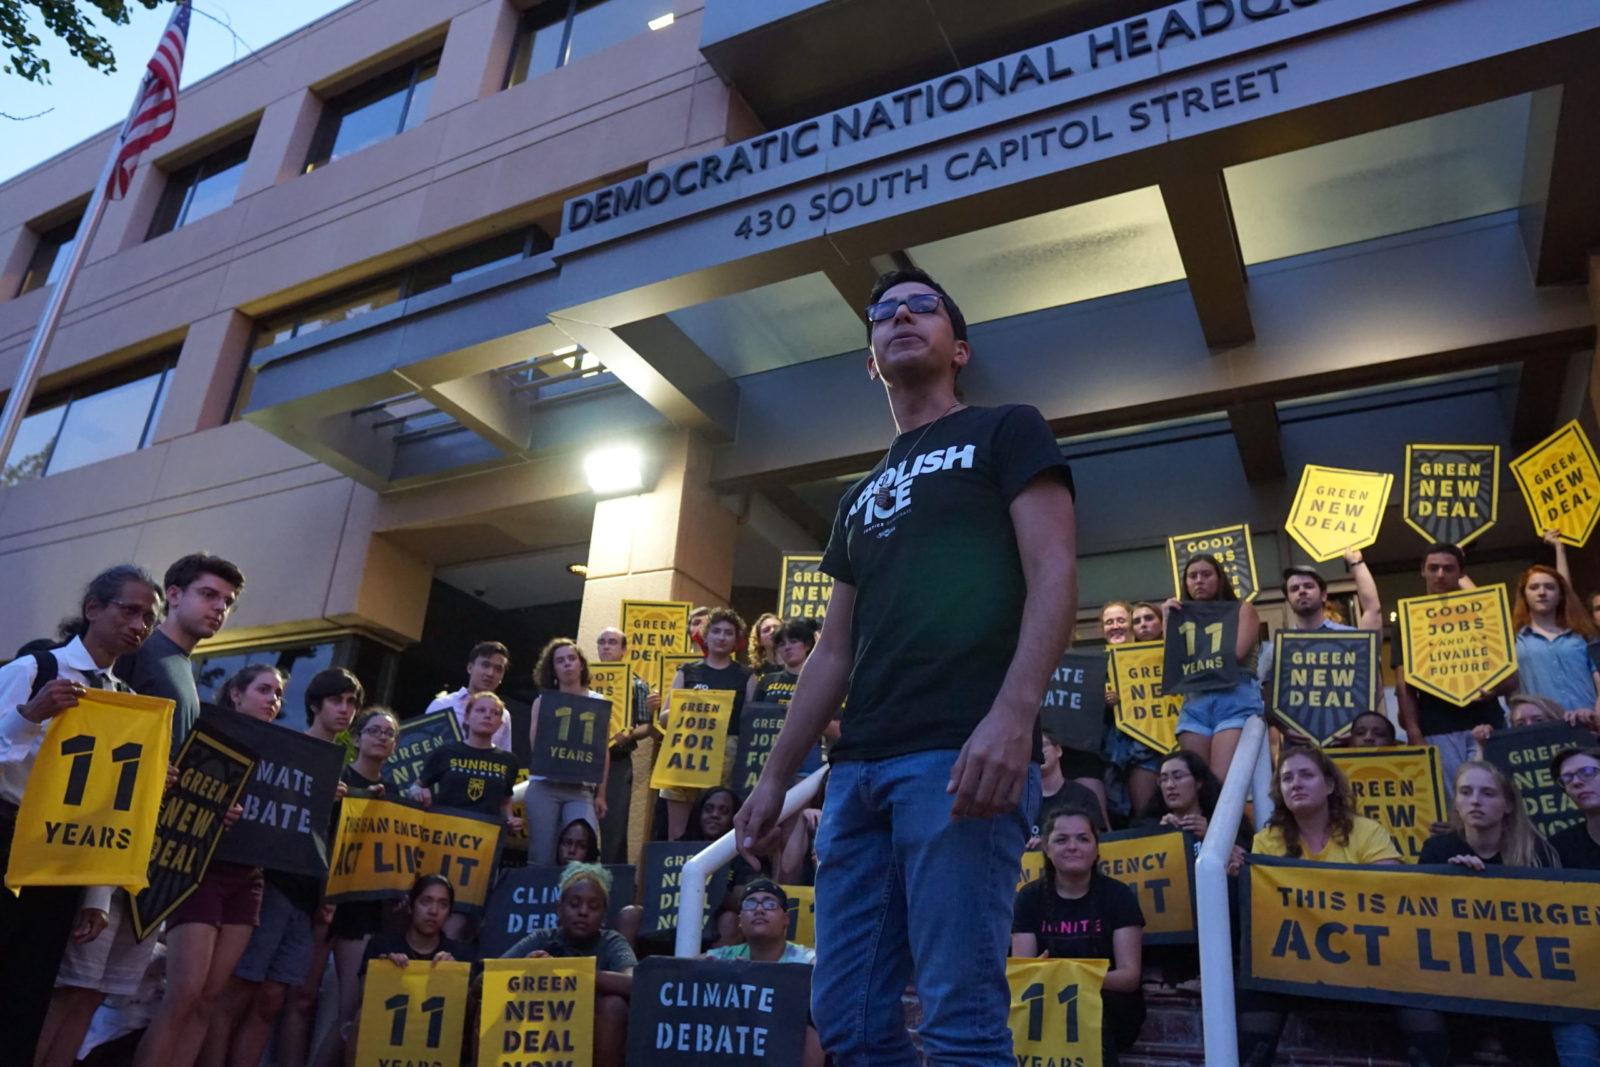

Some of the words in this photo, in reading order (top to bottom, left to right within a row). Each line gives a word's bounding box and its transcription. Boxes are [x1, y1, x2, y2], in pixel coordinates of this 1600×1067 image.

[568, 121, 820, 232] DEMOCRATIC
[832, 46, 1073, 146] NATIONAL
[1089, 0, 1320, 69] HEADQ
[734, 204, 796, 240] 430
[809, 164, 930, 221] SOUTH
[945, 115, 1113, 181] CAPITOL
[1129, 63, 1288, 132] STREET
[1420, 462, 1481, 477] GREEN
[1534, 452, 1577, 486] GREEN
[846, 444, 977, 528] BOLISH
[1316, 485, 1369, 501] GREEN
[1420, 479, 1480, 498] NEW
[1541, 467, 1584, 504] NEW
[1310, 499, 1364, 517] NEW
[1418, 501, 1480, 519] DEAL
[1547, 488, 1593, 522] DEAL
[1305, 515, 1358, 534] DEAL
[1187, 536, 1233, 553] GOOD
[1213, 550, 1235, 563] BS
[794, 571, 834, 583] GREE
[790, 604, 826, 618] DEA
[1426, 602, 1482, 619] GOOD
[634, 620, 676, 630] GREEN
[1428, 618, 1484, 636] JOBS
[632, 634, 675, 646] NEW
[1178, 620, 1224, 656] 11
[1291, 652, 1356, 665] GREEN
[1429, 646, 1488, 663] LIVABLE
[1128, 665, 1161, 680] GRE
[1182, 656, 1224, 676] YEARS
[1430, 661, 1489, 677] FUTURE
[1290, 669, 1355, 687] NEW
[1130, 683, 1163, 700] NE
[1289, 691, 1355, 707] DEAL
[681, 702, 720, 713] GREEN
[1132, 703, 1179, 719] DEA
[555, 706, 597, 745] 11
[676, 718, 716, 731] JOBS
[752, 718, 785, 728] GREE
[671, 734, 713, 750] FOR
[549, 745, 593, 763] YEARS
[667, 753, 710, 772] ALL
[746, 751, 769, 768] FO
[61, 735, 142, 812] 11
[392, 760, 425, 785] NE
[449, 758, 508, 775] SUNRISE
[181, 767, 229, 804] GREEN
[257, 760, 314, 797] MATE
[1513, 768, 1556, 790] NE
[1352, 780, 1414, 797] REEN
[1522, 792, 1580, 816] DEA
[160, 797, 216, 838] NEW
[243, 794, 312, 834] BATE
[1364, 805, 1415, 828] EW
[45, 821, 133, 849] YEARS
[440, 854, 478, 886] IT
[1101, 852, 1168, 877] GENCY
[1277, 887, 1347, 911] THIS
[1357, 892, 1386, 914] IS
[1397, 895, 1439, 917] AN
[1451, 898, 1600, 927] EMERGE
[507, 912, 559, 934] DEB
[1271, 919, 1390, 966] ACT
[1416, 928, 1577, 982] LIKE
[508, 976, 578, 993] GREEN
[659, 982, 775, 1013] CLIMATE
[385, 993, 446, 1048] 11
[505, 1000, 576, 1022] NEW
[1021, 983, 1079, 1042] 11
[503, 1030, 575, 1053] DEAL
[655, 1021, 769, 1057] DEBATE
